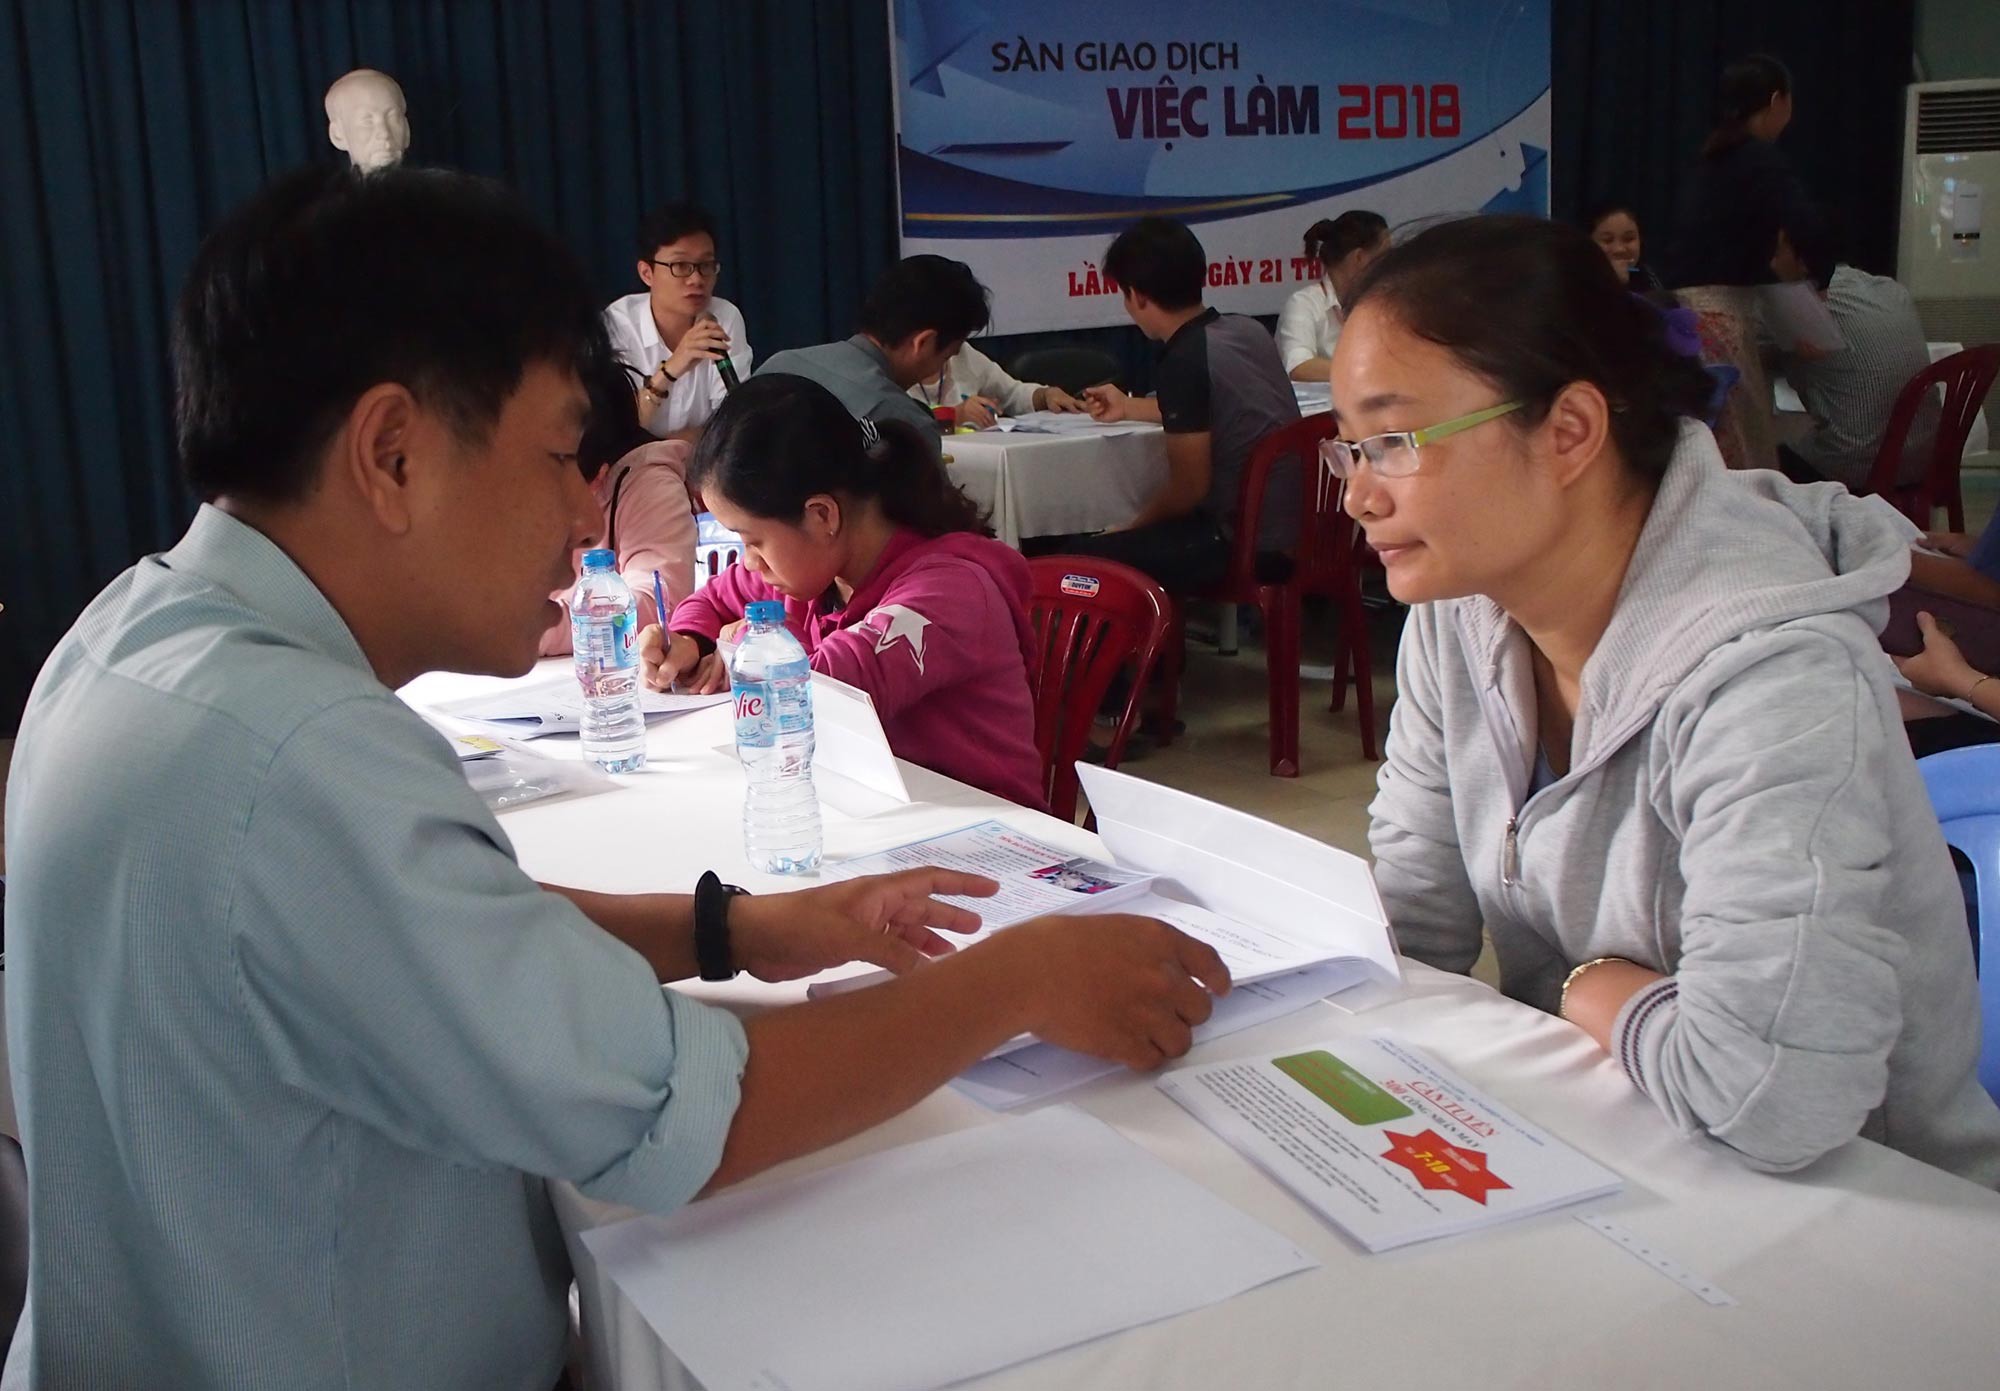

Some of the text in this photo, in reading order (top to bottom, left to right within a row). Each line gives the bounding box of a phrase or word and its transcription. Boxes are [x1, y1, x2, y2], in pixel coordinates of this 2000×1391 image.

[991, 35, 1238, 76] SÀN GIAO DỊCH
[1106, 73, 1461, 151] VIỆC LÀM 2018
[1200, 255, 1253, 288] GÀY
[1259, 258, 1282, 283] 21
[1414, 1150, 1452, 1173] 7-10
